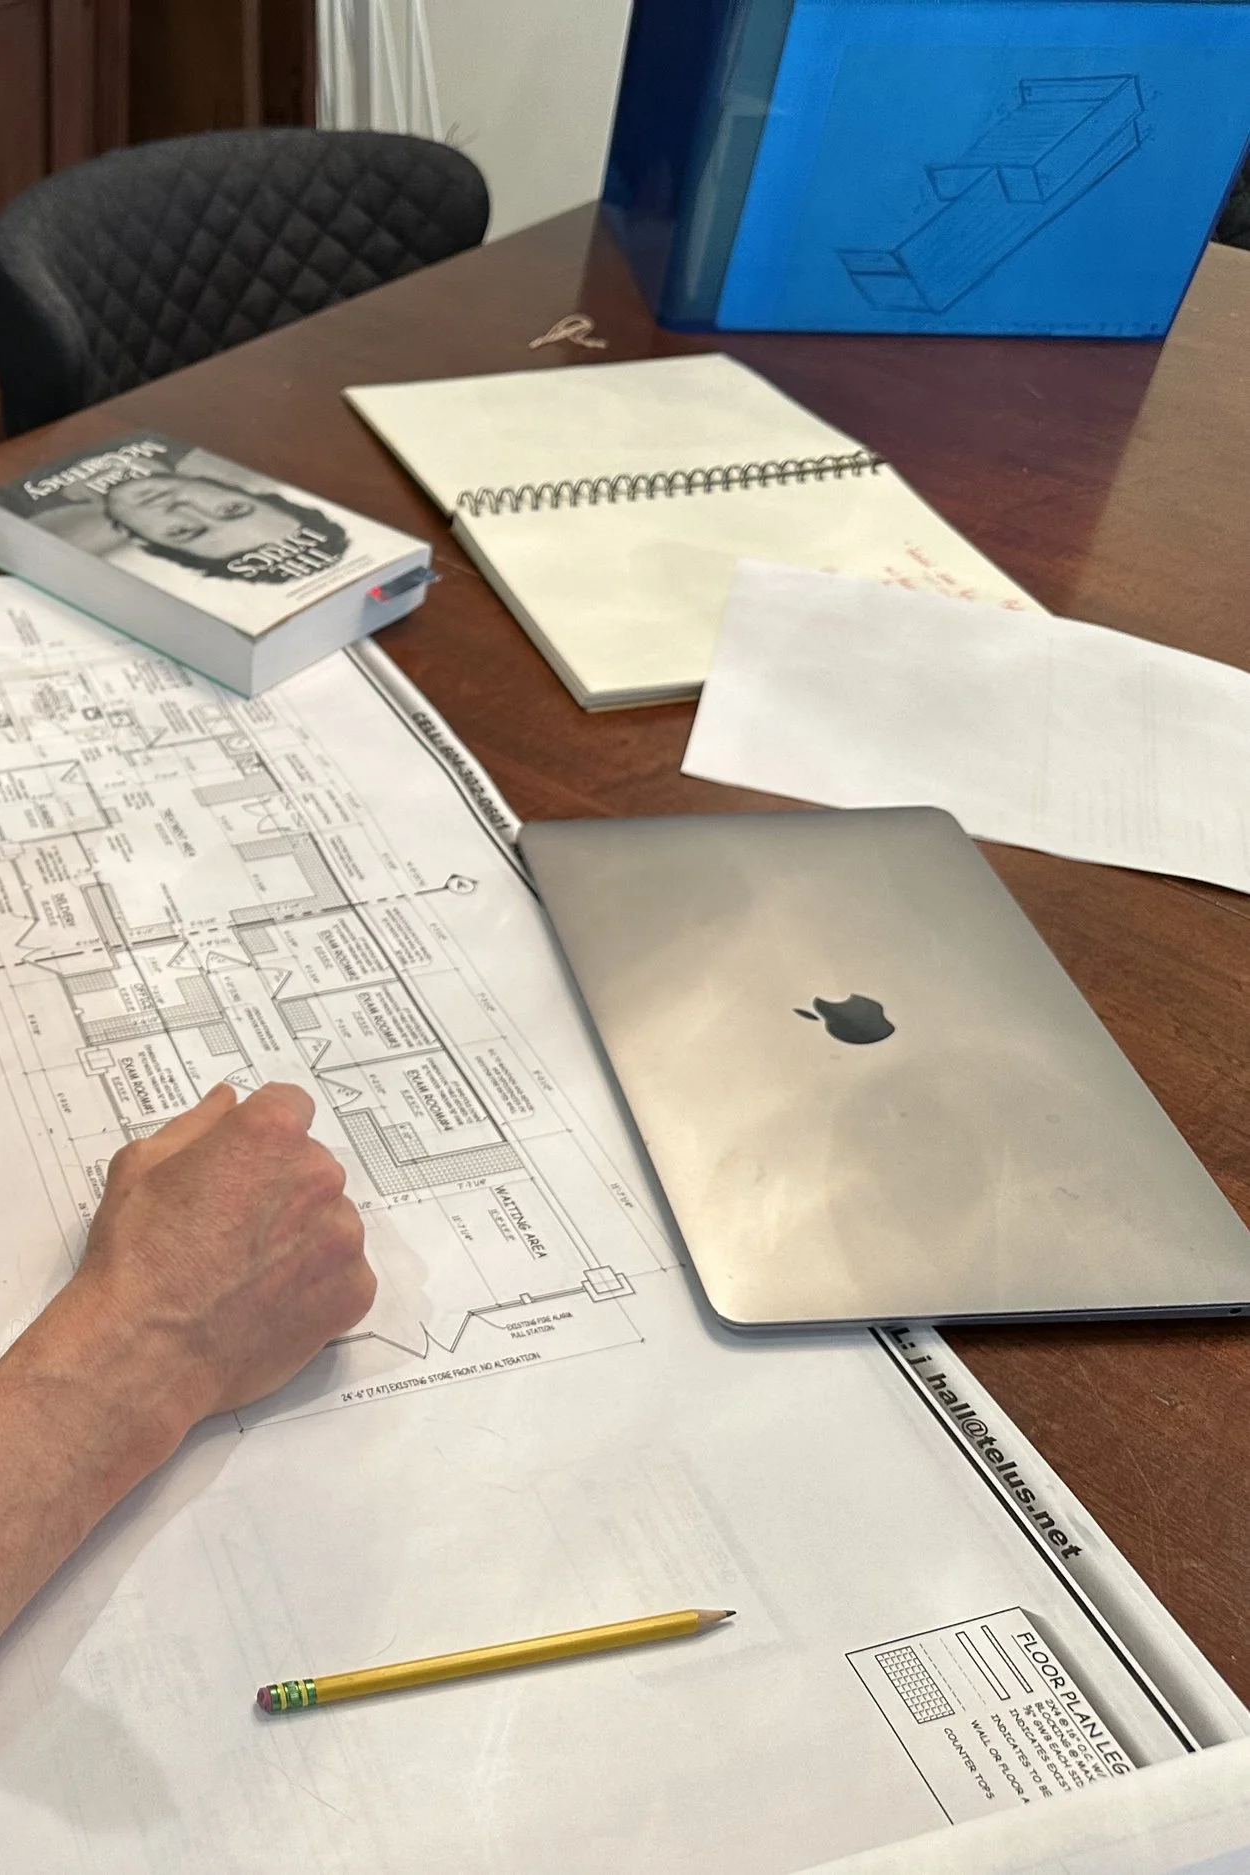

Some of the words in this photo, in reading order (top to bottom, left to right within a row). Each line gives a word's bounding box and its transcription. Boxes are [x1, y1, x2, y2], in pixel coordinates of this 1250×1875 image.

[23, 440, 168, 501] McCartney
[227, 527, 328, 578] LYRICS
[281, 548, 341, 577] THE
[121, 1057, 139, 1080] EXAM
[406, 1069, 429, 1093] EXAM
[495, 1185, 531, 1230] WAITING
[524, 1233, 547, 1258] AREA
[526, 1325, 555, 1336] STATION
[388, 1376, 427, 1391] EXISTING
[427, 1370, 453, 1382] STORE
[479, 1362, 493, 1371] NO
[906, 1354, 1083, 1559] j_hall@telus.net
[1017, 1632, 1065, 1689] FLOOR
[1060, 1691, 1103, 1739] PLAN
[1009, 1708, 1050, 1762] INDICATES
[1033, 1720, 1052, 1742] GWB
[1049, 1742, 1072, 1768] EACH
[1034, 1702, 1071, 1748] BLOCKING
[1068, 1749, 1079, 1758] @
[1059, 1718, 1069, 1727] @
[944, 1728, 977, 1773] COUNTER
[975, 1773, 995, 1800] TOPS
[971, 1719, 990, 1747] WALL
[989, 1748, 1002, 1762] OR
[998, 1763, 1023, 1793] FLOOR
[990, 1713, 1031, 1767] INDICATES
[1029, 1768, 1042, 1783] TO
[1038, 1785, 1053, 1798] BE
